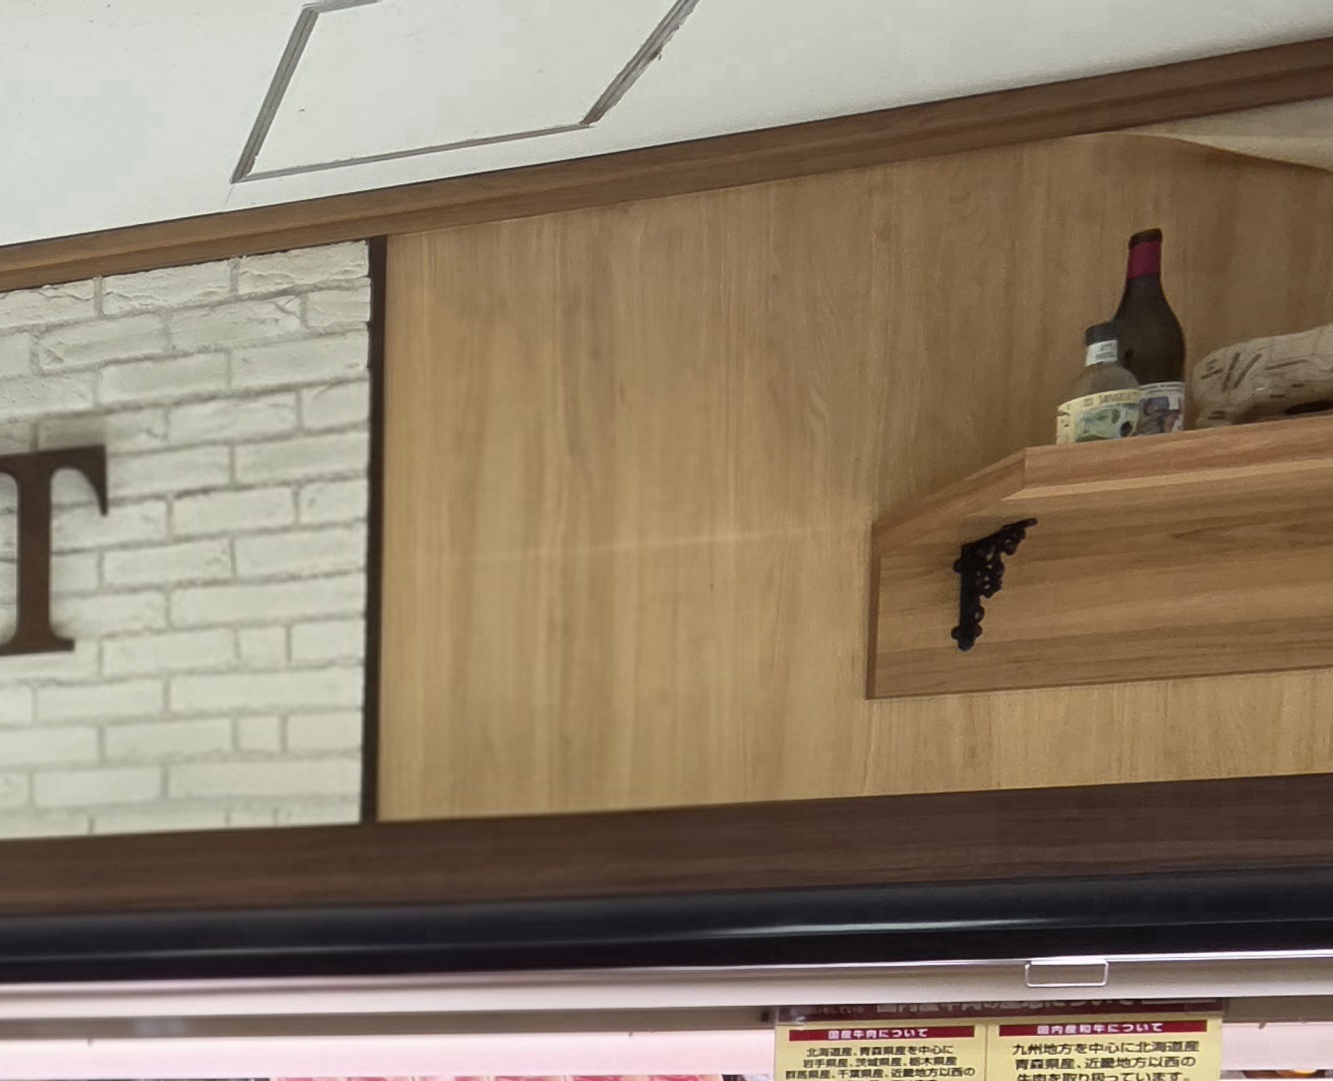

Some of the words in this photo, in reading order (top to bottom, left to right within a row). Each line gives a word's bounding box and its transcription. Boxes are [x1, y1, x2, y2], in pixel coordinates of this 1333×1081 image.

[828, 1028, 929, 1040] 国産牛肉について
[1036, 1023, 1163, 1035] 国内産和牛について
[806, 1045, 954, 1058] 北海道産、青森県産を中心に
[1012, 1041, 1199, 1055] 九州地方を中心に北海道産
[1015, 1056, 1196, 1071] 青森県産、近畿地方以西の
